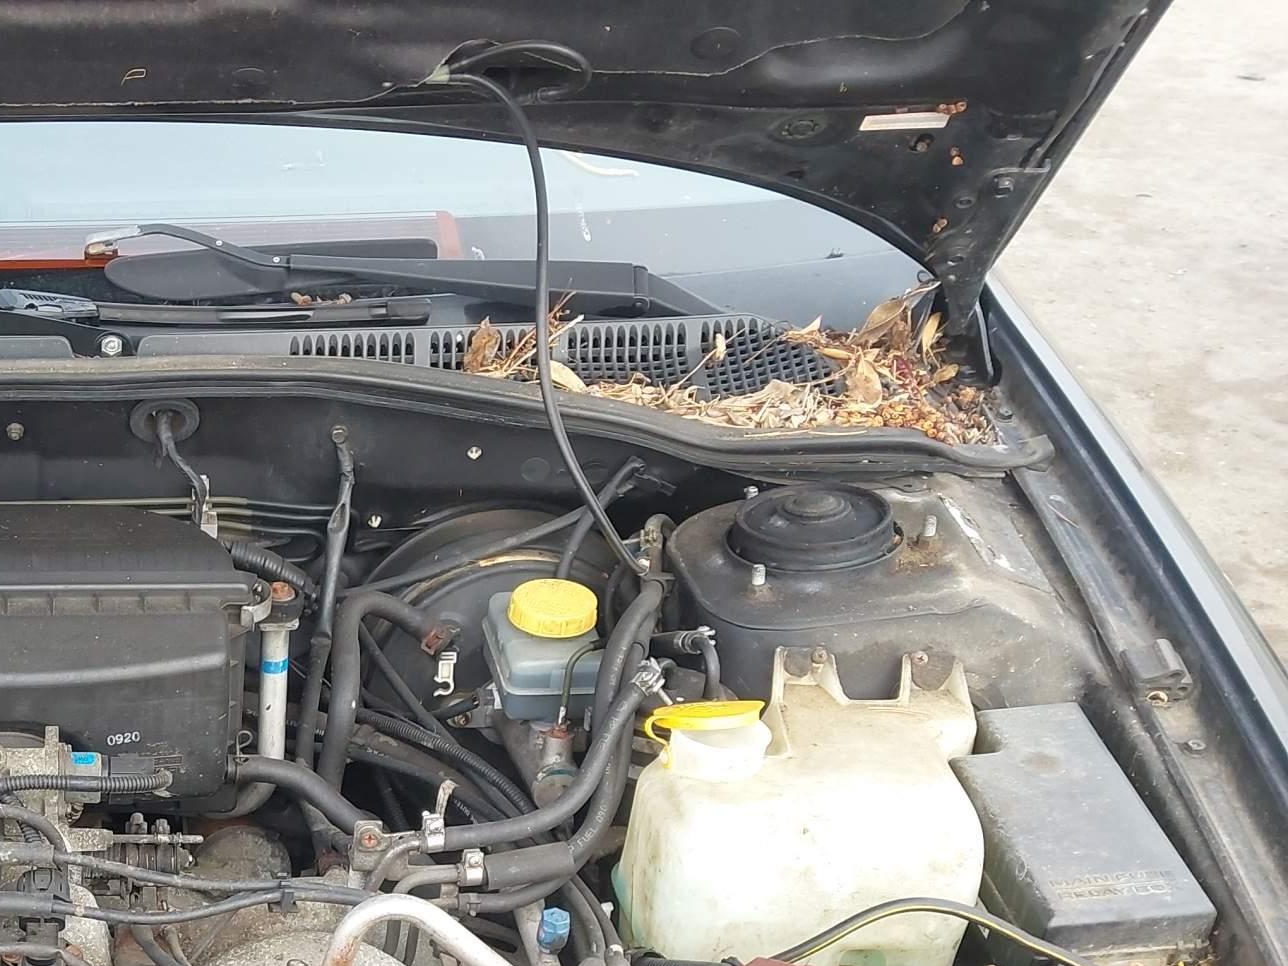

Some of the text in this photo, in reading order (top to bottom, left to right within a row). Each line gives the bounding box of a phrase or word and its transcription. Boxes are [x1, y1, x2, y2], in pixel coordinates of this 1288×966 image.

[107, 731, 141, 746] 0920
[577, 826, 597, 848] FUEL
[1049, 872, 1109, 888] MAIN
[1057, 888, 1128, 900] RELAY
